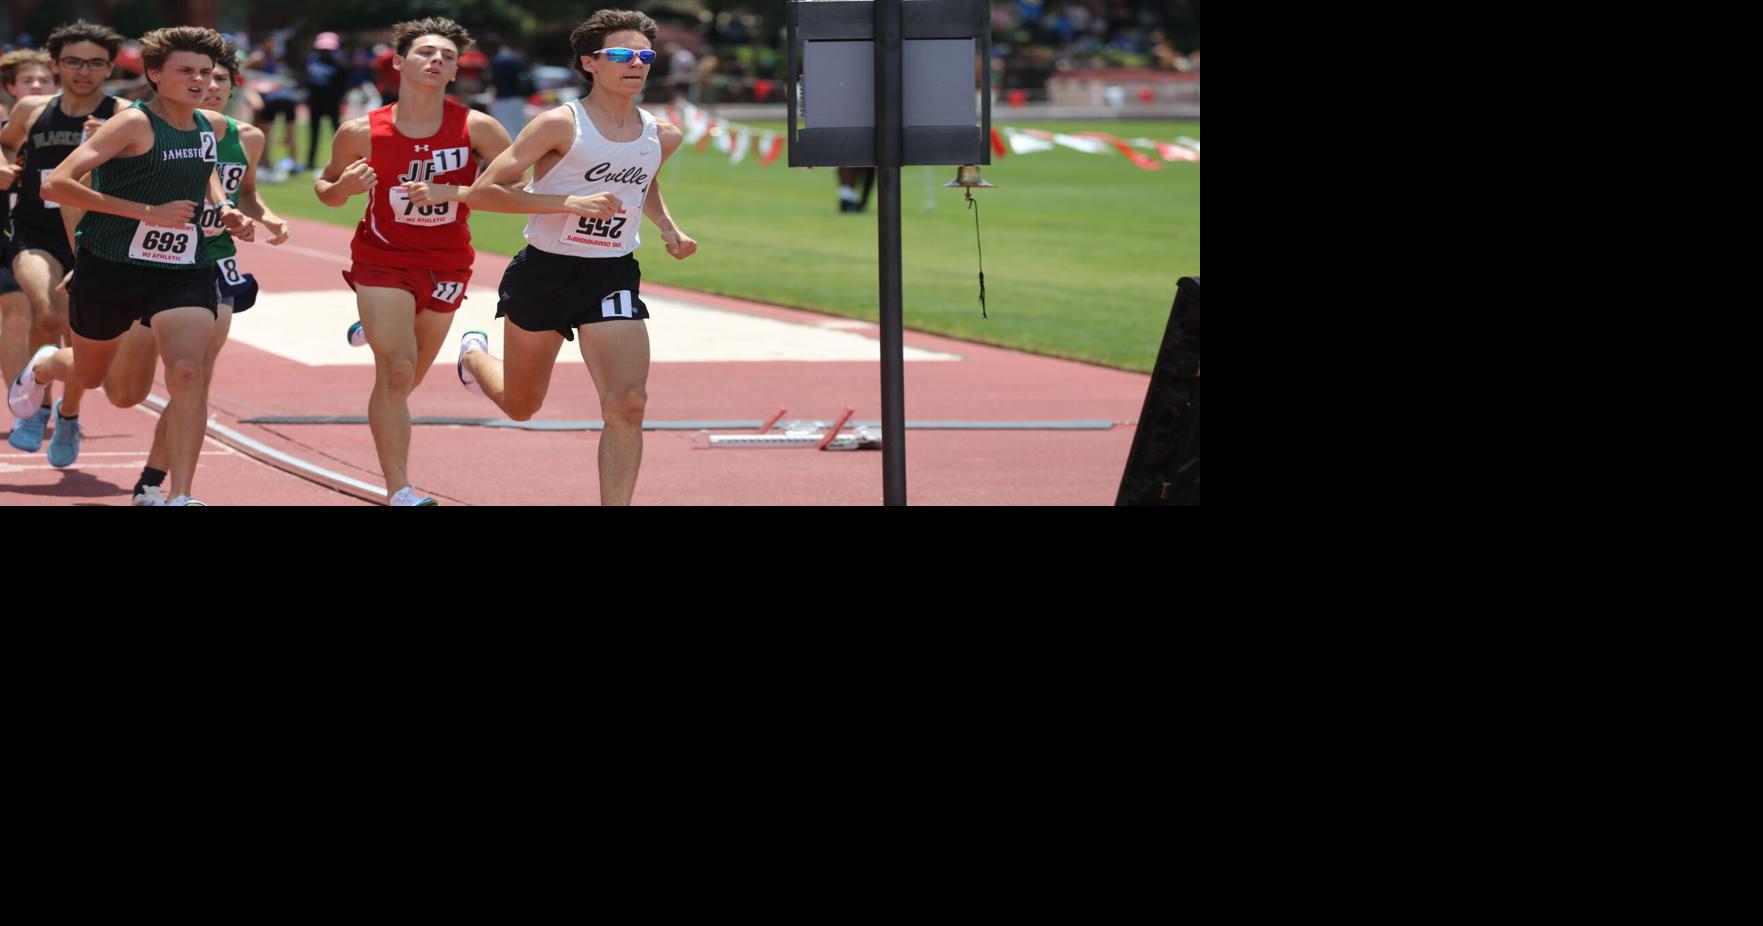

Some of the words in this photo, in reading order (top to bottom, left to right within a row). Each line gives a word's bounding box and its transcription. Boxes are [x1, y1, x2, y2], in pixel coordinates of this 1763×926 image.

[203, 134, 215, 160] 2
[436, 148, 461, 170] 11
[226, 167, 242, 192] 8
[584, 162, 648, 184] Cville
[576, 216, 626, 239] 255
[142, 230, 189, 254] 693
[152, 252, 181, 261] ATHLETIC
[223, 258, 240, 283] 8
[437, 282, 458, 300] 11
[606, 292, 622, 315] 1
